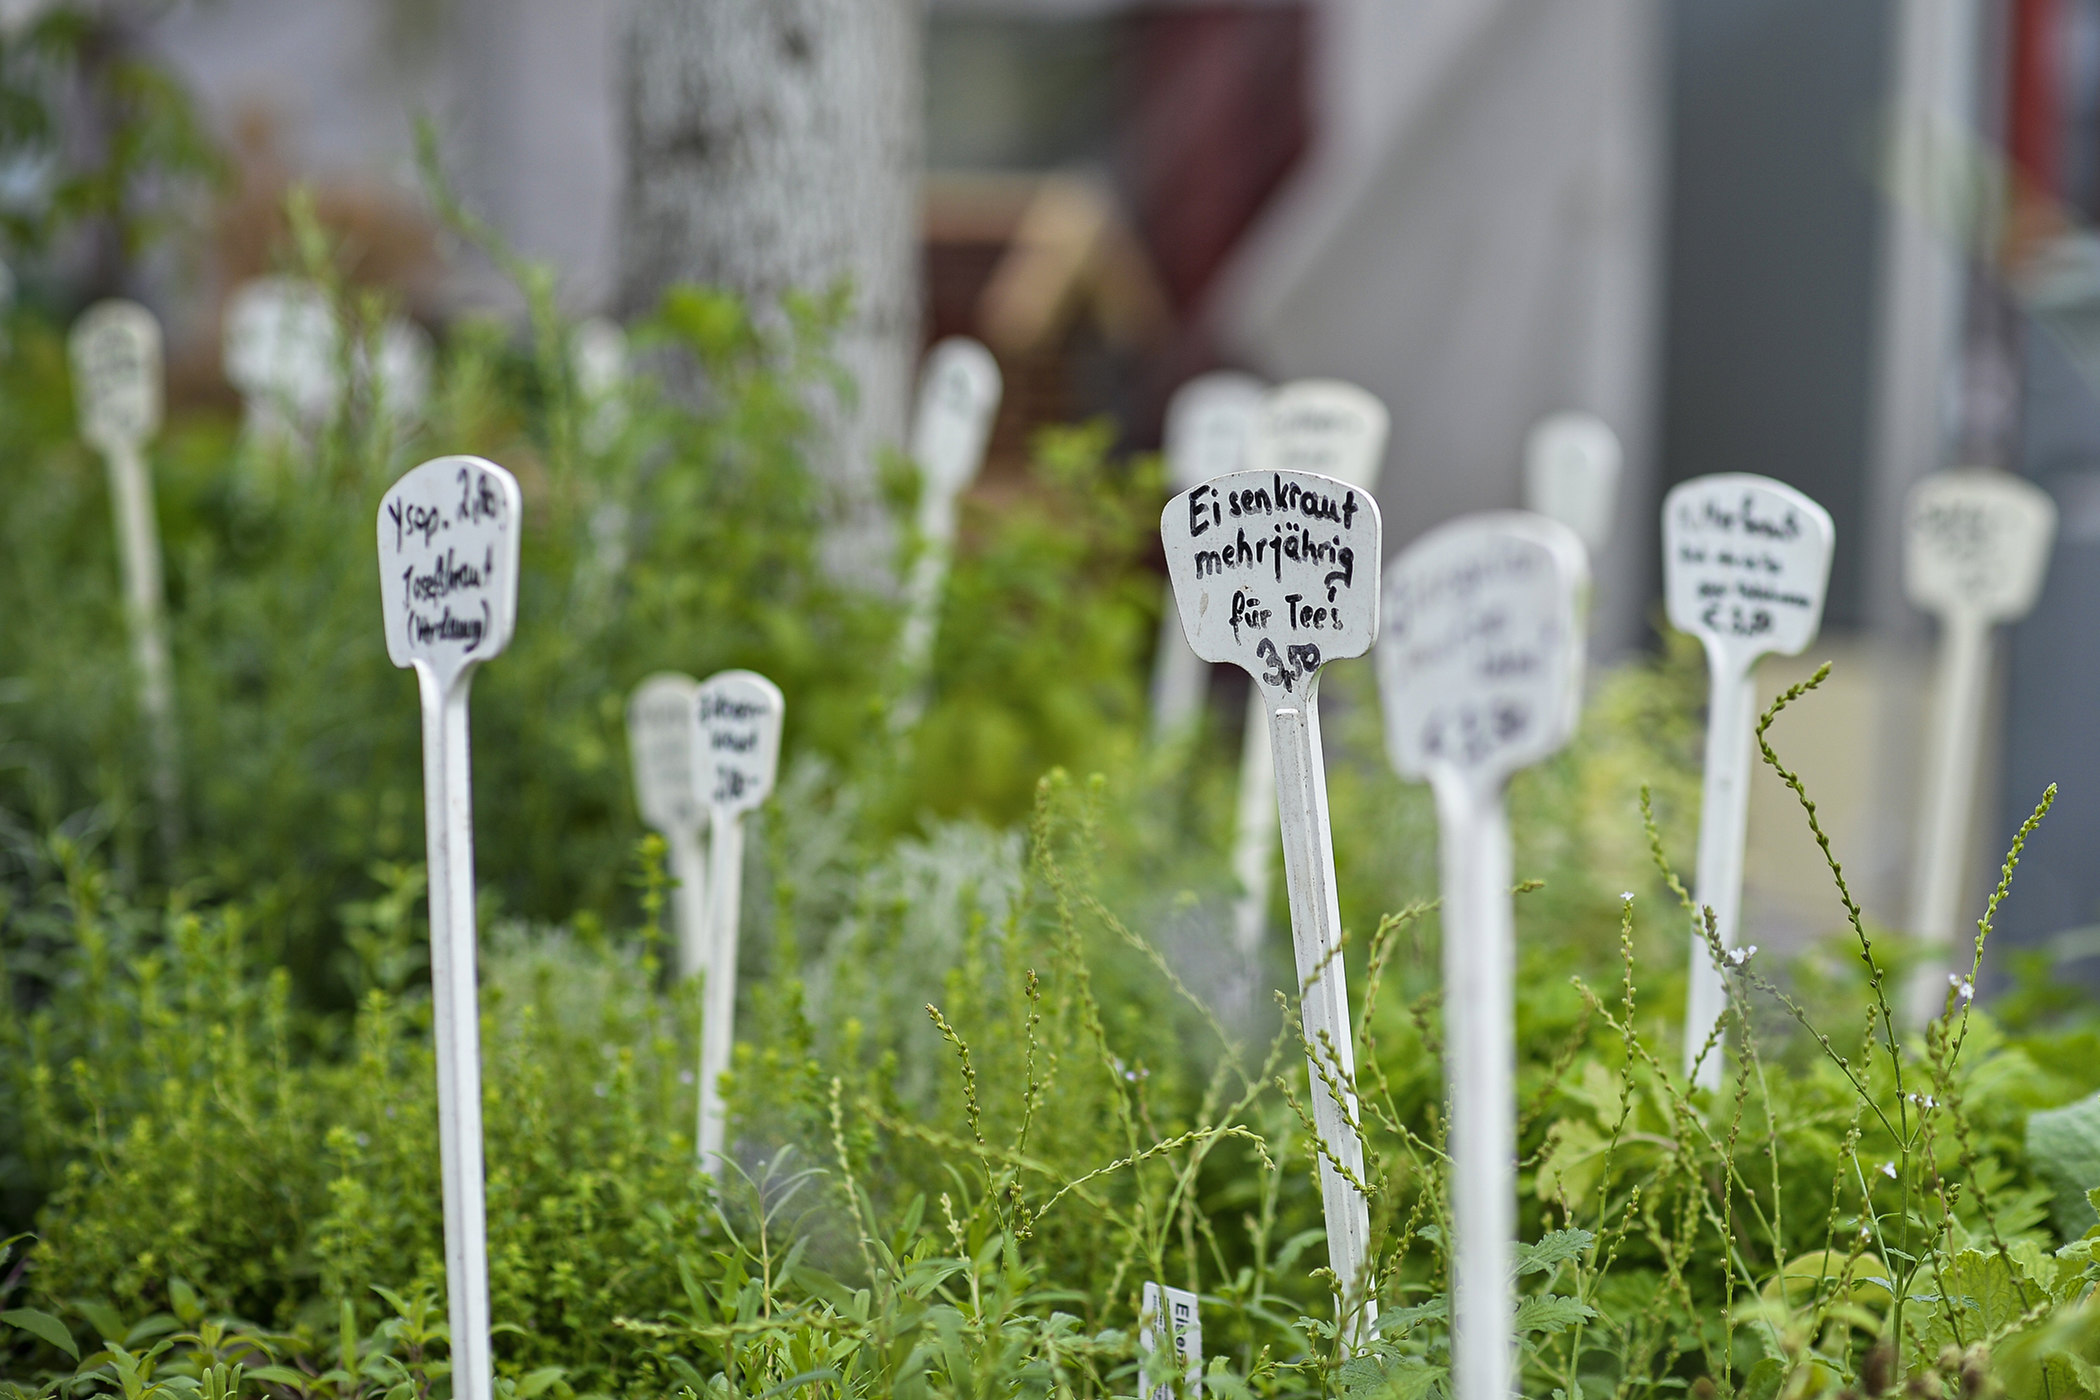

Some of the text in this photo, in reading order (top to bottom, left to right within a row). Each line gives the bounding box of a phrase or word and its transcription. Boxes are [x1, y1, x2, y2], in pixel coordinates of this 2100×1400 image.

[1189, 472, 1359, 537] Eisenkraut
[1194, 521, 1355, 589] mehrjährig
[1229, 590, 1272, 646] für
[1256, 637, 1321, 693] 3,50
